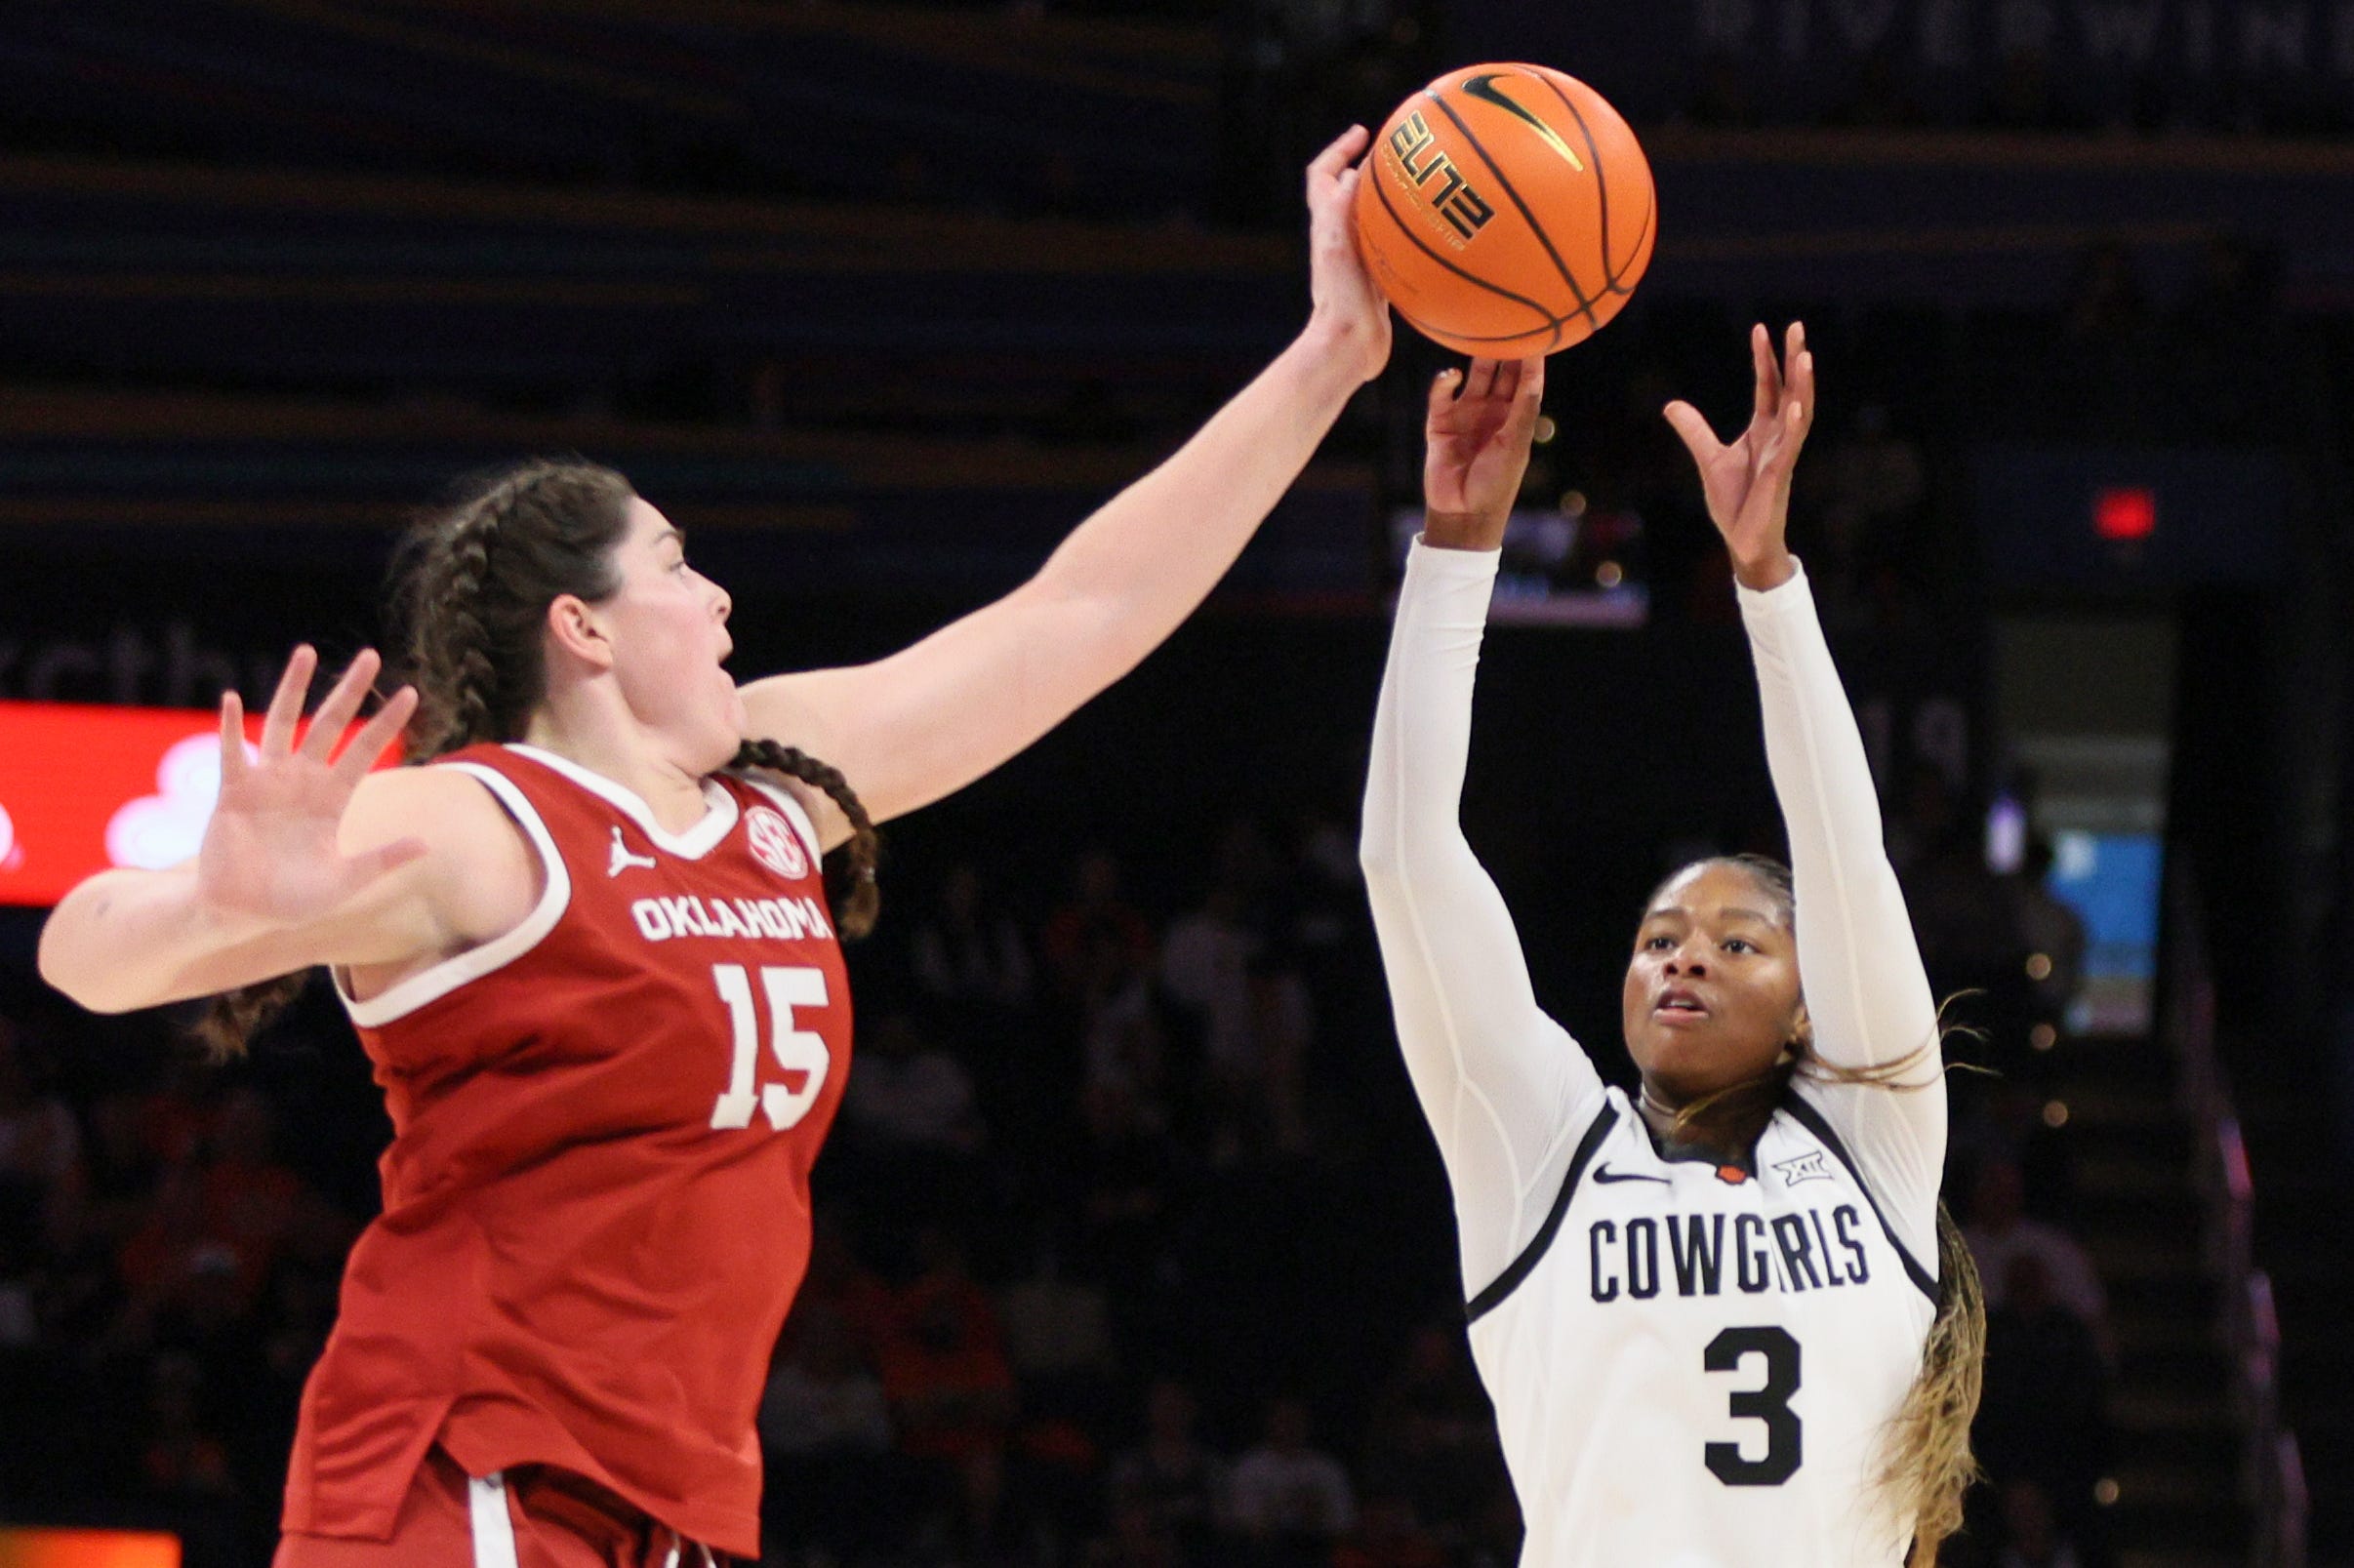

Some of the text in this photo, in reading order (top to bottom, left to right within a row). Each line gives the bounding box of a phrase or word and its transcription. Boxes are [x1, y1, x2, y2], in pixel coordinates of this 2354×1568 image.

[1390, 109, 1496, 241] ELITE
[710, 963, 830, 1132] 15
[1590, 1204, 1870, 1304] COWGRLS
[1704, 1325, 1804, 1486] 3
